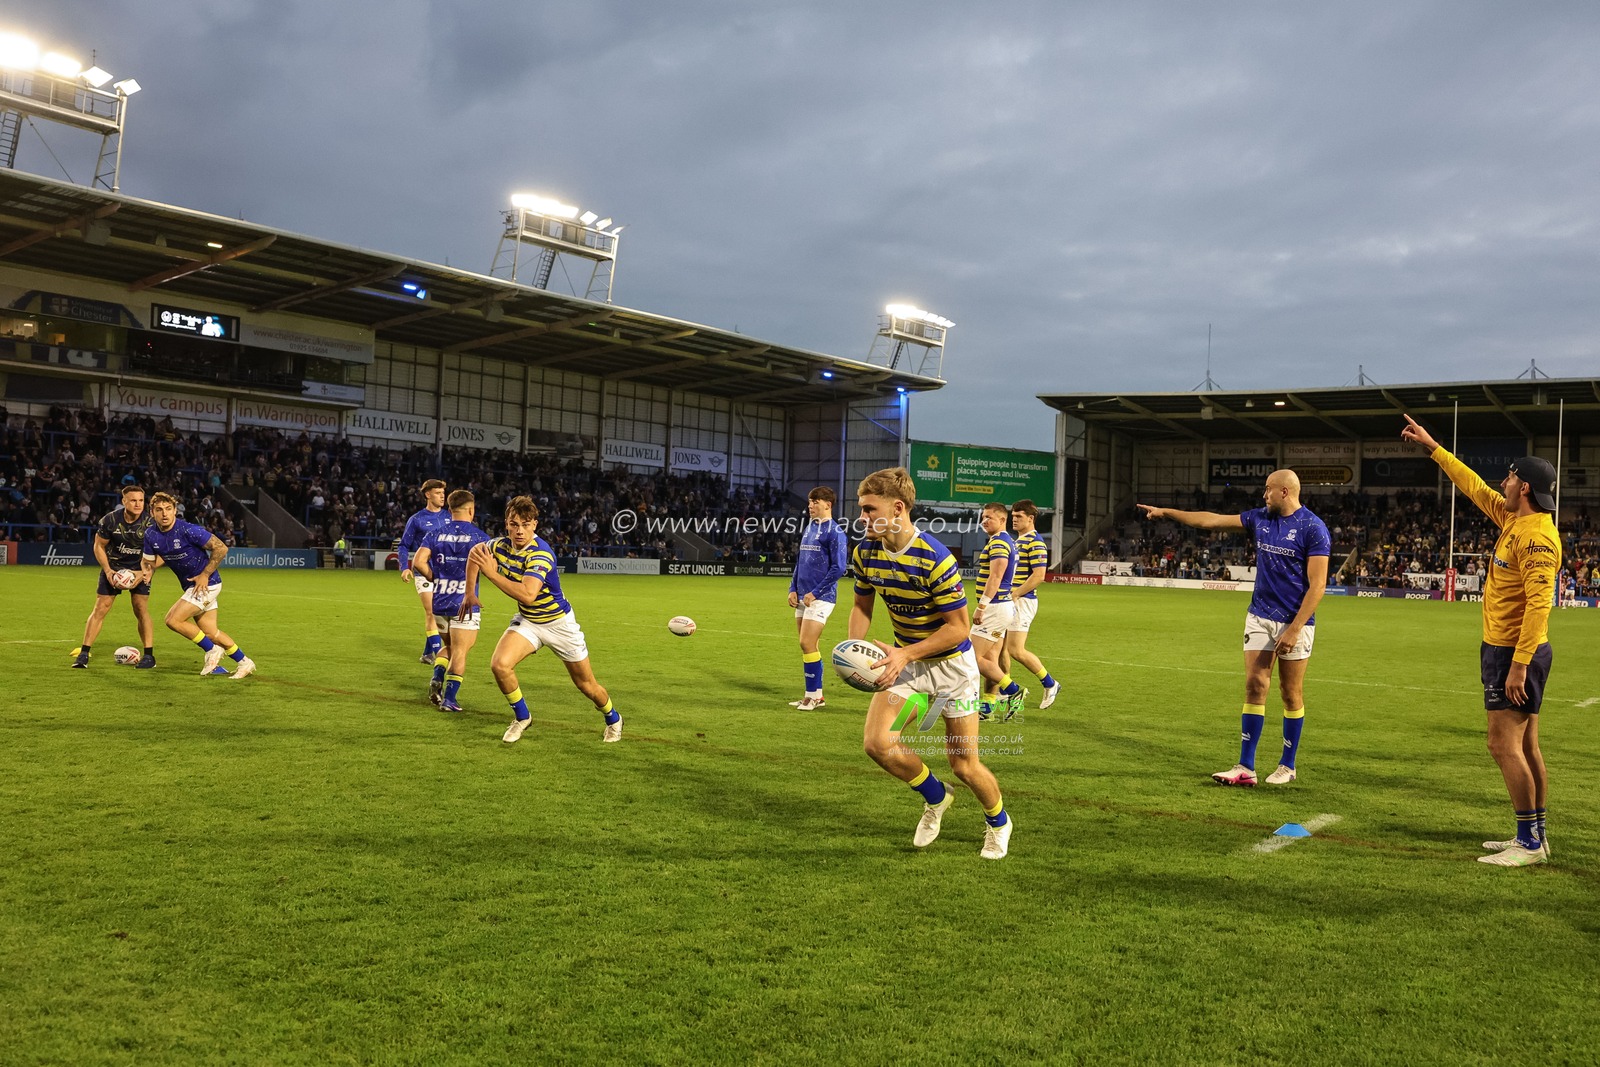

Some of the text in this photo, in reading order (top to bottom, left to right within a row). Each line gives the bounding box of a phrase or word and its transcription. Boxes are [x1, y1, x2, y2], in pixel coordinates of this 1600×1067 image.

[71, 306, 113, 322] Chester
[117, 387, 223, 417] Your campus
[240, 403, 337, 429] in Warrington
[352, 413, 486, 443] HALLIWELL JONES
[605, 443, 702, 466] HALLIWELL JONES
[957, 457, 989, 469] Equipping
[989, 461, 1010, 471] people
[1018, 462, 1049, 472] transform
[956, 467, 1031, 480] places, spaces and lives.
[437, 533, 472, 543] HAYES
[271, 554, 306, 567] Jones
[582, 559, 659, 573] Watsons Solicitors
[669, 565, 726, 577] SEAT UNIQUE
[1053, 575, 1069, 583] JOHN
[1070, 576, 1098, 584] CHORLEY
[1357, 590, 1383, 599] BOOST
[1405, 592, 1431, 600] BOOST
